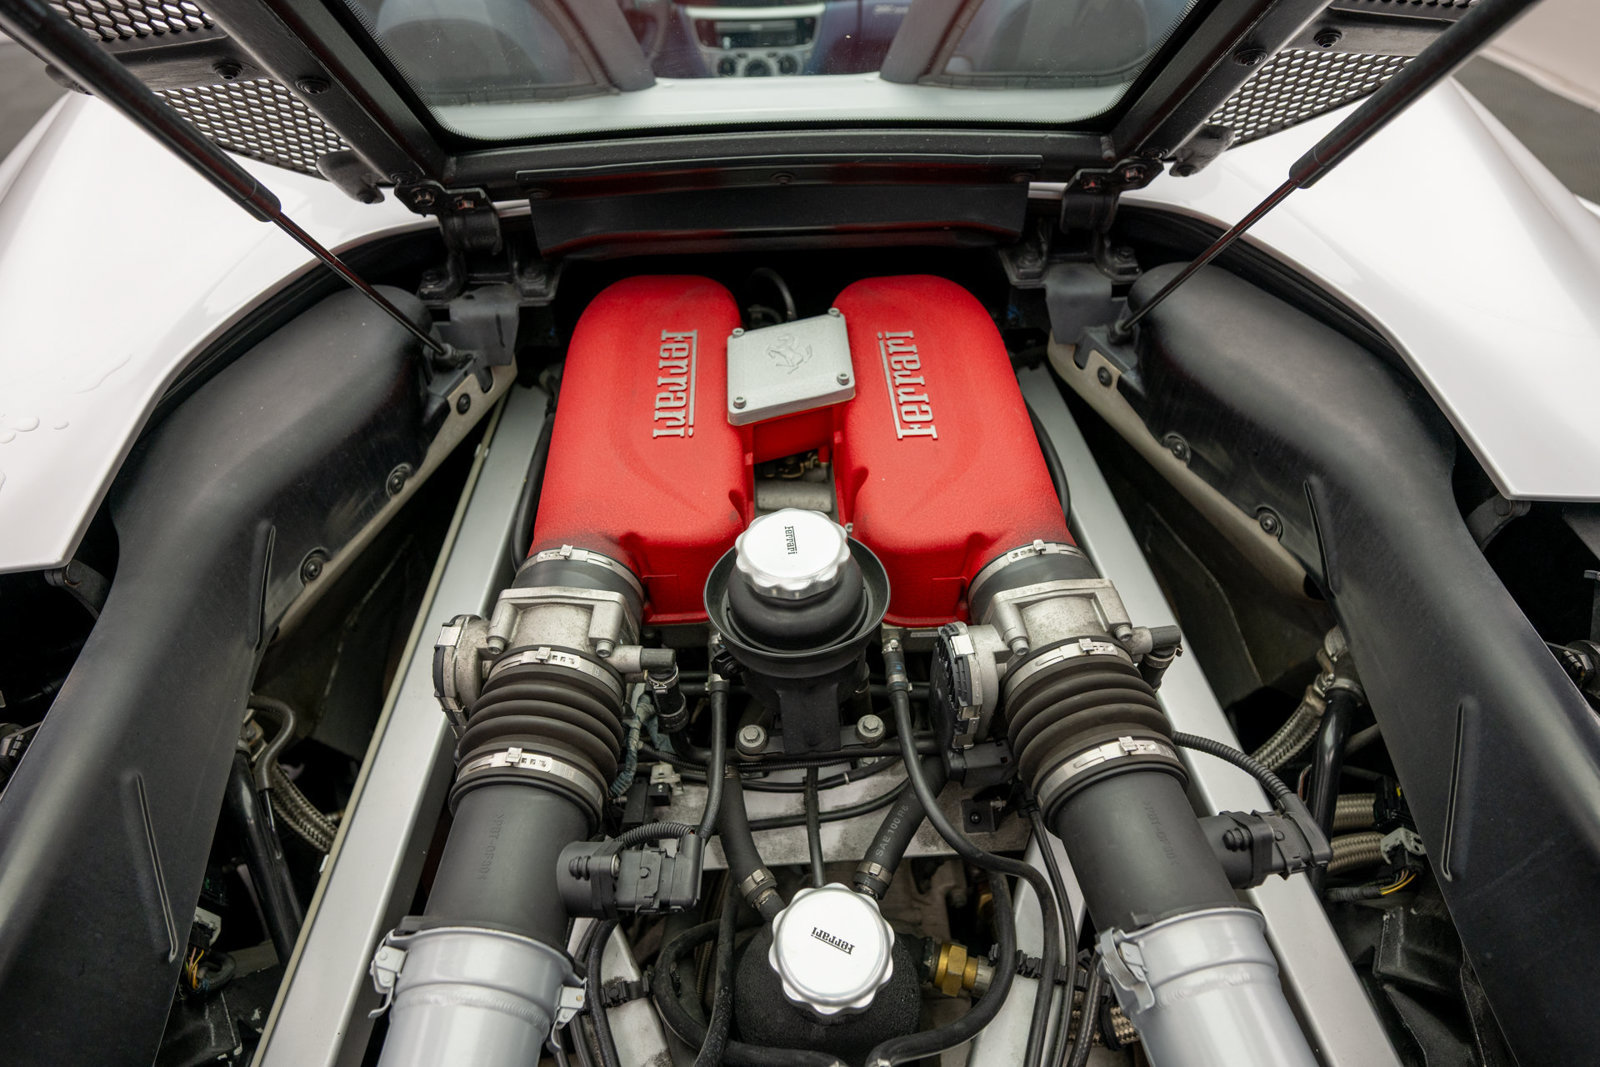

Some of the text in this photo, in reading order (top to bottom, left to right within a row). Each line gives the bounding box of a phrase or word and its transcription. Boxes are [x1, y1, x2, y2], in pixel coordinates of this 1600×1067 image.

[653, 329, 698, 439] Ferrari
[877, 330, 938, 440] Ferrari
[784, 525, 798, 555] Ferrari
[876, 836, 891, 857] SAE
[810, 926, 855, 955] Ferrari
